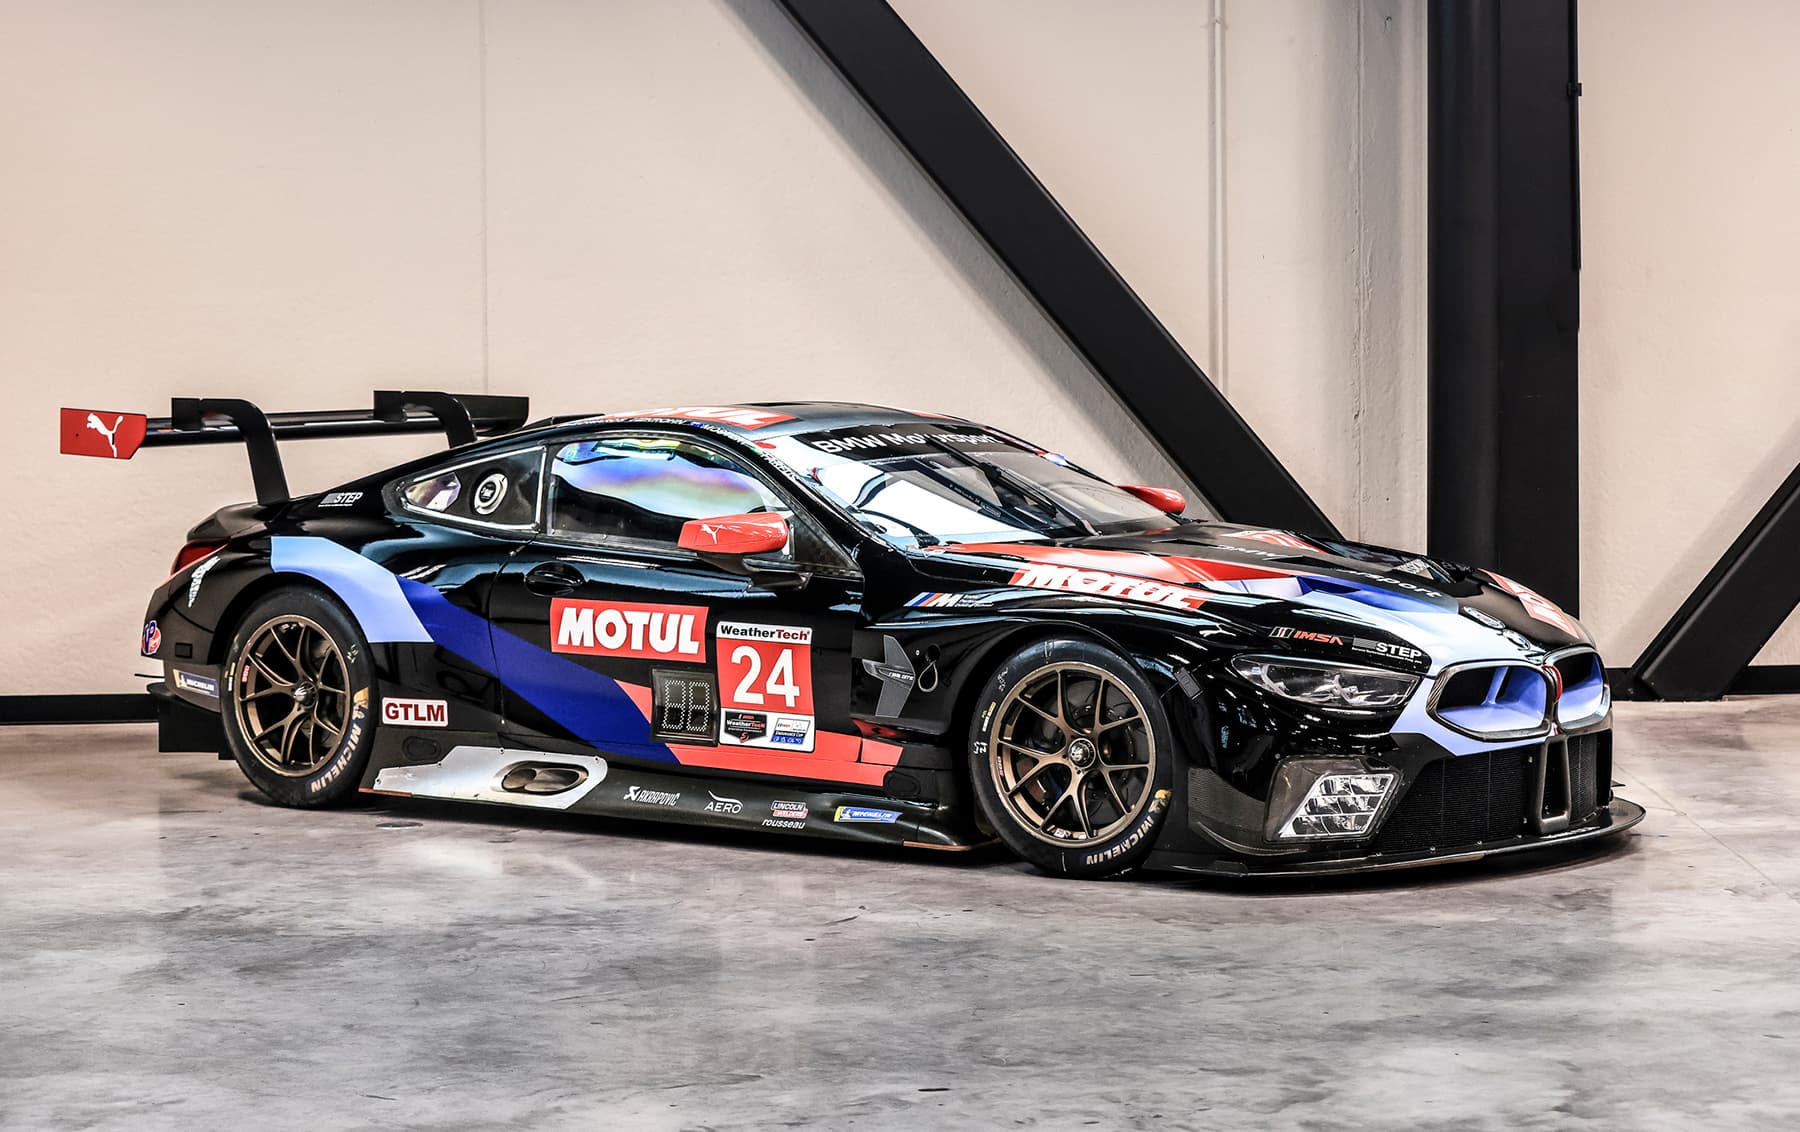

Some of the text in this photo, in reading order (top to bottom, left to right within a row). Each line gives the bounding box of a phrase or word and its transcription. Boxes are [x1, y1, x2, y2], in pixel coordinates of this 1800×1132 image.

[811, 434, 887, 453] BMW
[335, 492, 363, 501] STEP
[1012, 562, 1203, 608] MOTUL
[557, 607, 700, 654] MOTUL
[720, 625, 808, 641] WeatherTech
[1294, 631, 1344, 646] IMSA
[1376, 641, 1422, 658] STEP
[731, 645, 800, 708] 24
[384, 702, 445, 722] GTLM
[311, 722, 362, 794] MICHELIN
[704, 801, 742, 814] AERO
[773, 802, 803, 811] LINCOLN
[762, 819, 806, 830] rousseau
[1085, 815, 1156, 866] MICHELIN
